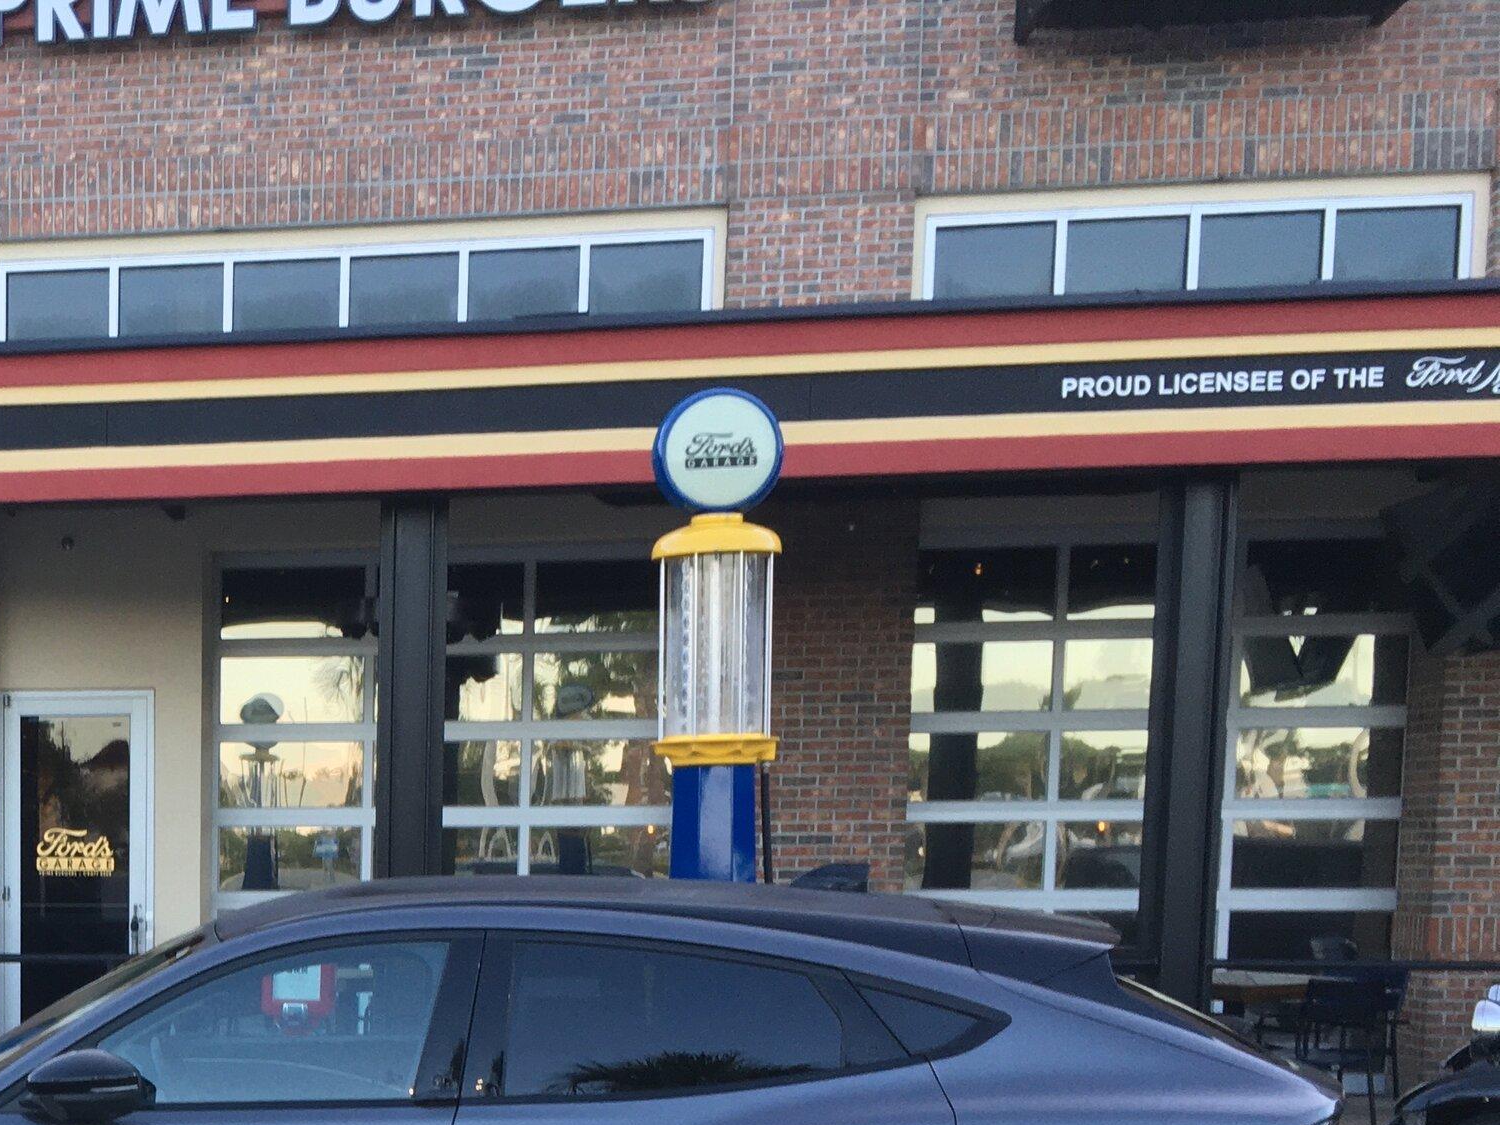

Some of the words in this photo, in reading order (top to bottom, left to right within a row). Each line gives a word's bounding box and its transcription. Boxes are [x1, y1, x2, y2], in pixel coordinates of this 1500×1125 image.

[1062, 375, 1152, 398] PROUD
[1158, 370, 1283, 395] LICENSEE
[1290, 369, 1326, 390] OF
[1333, 366, 1384, 389] THE
[1405, 355, 1486, 388] Ford
[37, 827, 113, 857] Ford's
[38, 859, 113, 870] GARAGE
